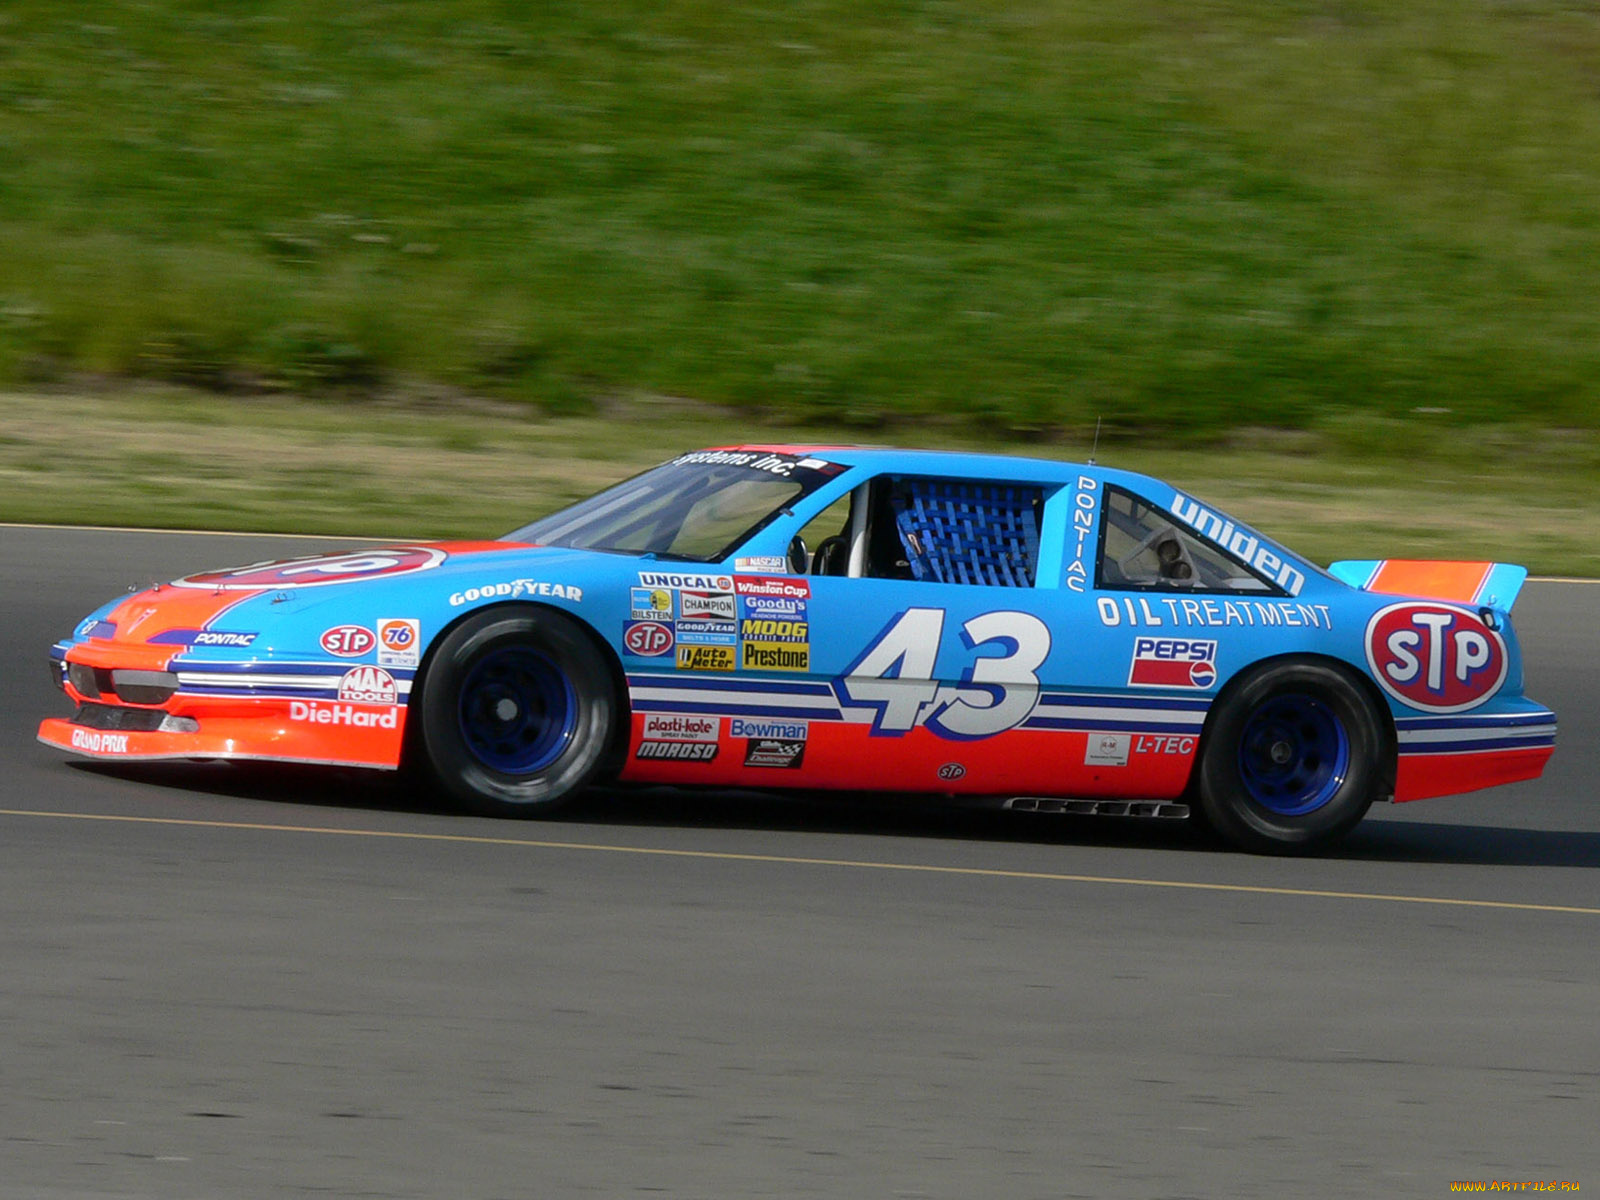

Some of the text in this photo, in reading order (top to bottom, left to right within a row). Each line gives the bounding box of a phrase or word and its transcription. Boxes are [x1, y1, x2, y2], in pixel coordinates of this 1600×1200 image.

[1066, 475, 1098, 593] PONTIAC
[1170, 493, 1305, 597] uniden
[641, 574, 717, 589] UNOCAL
[737, 582, 808, 598] Winston Cup
[449, 579, 583, 606] GOODYEAR
[684, 599, 732, 611] CHAMPION
[746, 597, 806, 614] Goody's
[1097, 597, 1332, 630] OIL TREATMENT
[632, 610, 672, 620] BILSTEIN
[386, 627, 411, 644] 76
[677, 623, 736, 632] GOODYEAR
[742, 620, 808, 637] MOOG
[194, 633, 256, 646] PONTIAC
[326, 628, 369, 651] STP
[631, 626, 667, 650] STP
[695, 648, 727, 659] Auto
[745, 643, 807, 668] Prestone
[1136, 639, 1215, 661] PEPSI
[1386, 612, 1490, 692] STP
[691, 657, 733, 669] Meter
[341, 668, 395, 693] MAC
[836, 606, 1052, 739] 43
[342, 690, 394, 701] TOOLS
[290, 701, 398, 729] DieHard
[648, 717, 713, 733] plasti-kote
[732, 720, 807, 739] Bowman
[72, 729, 129, 753] GRAND PRIX
[636, 741, 718, 759] MOROSO
[1135, 735, 1194, 754] L-TEC
[940, 764, 963, 778] STP
